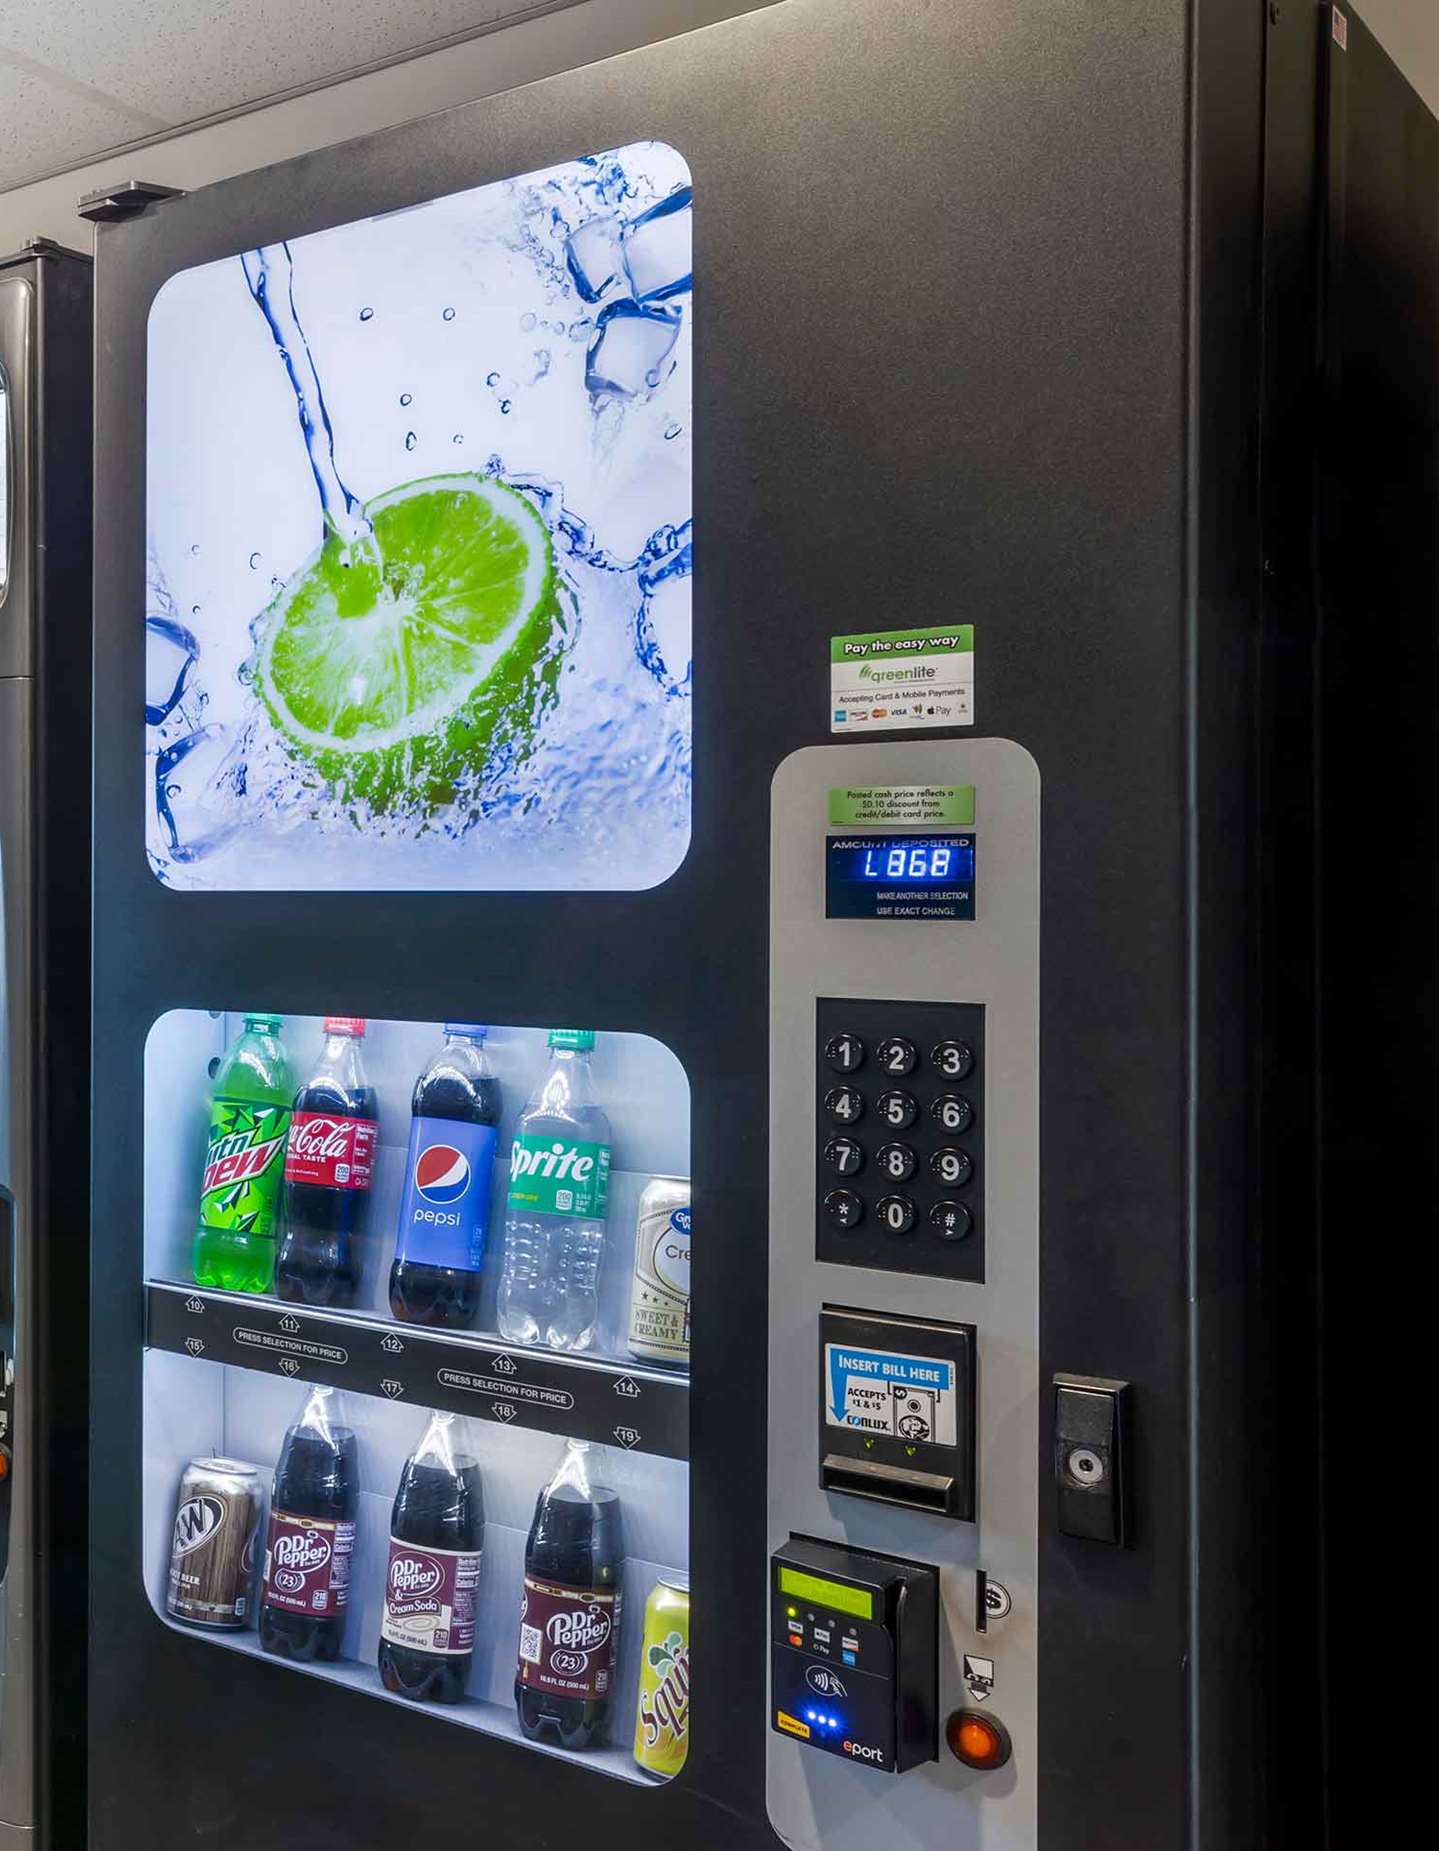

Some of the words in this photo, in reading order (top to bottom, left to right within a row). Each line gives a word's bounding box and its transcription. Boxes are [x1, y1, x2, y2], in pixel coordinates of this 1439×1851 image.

[845, 643, 869, 655] Pay
[872, 640, 892, 651] the
[895, 639, 926, 651] easy
[930, 636, 960, 648] way
[871, 666, 935, 684] greenlite
[839, 695, 874, 703] Accepting
[875, 692, 893, 701] Card
[894, 692, 900, 700] &
[902, 690, 926, 699] Mobile
[928, 688, 965, 698] Payments
[935, 706, 952, 716] Pay
[847, 791, 872, 799] Posted
[874, 791, 892, 799] cash
[894, 790, 914, 800] price
[917, 788, 946, 798] reflects
[886, 800, 919, 808] discount
[855, 810, 901, 819] credit/debit
[903, 810, 921, 818] card
[877, 892, 895, 900] MAKE
[895, 892, 929, 900] ANOTHER
[930, 892, 969, 900] SELECTION
[876, 907, 892, 915] USE
[894, 907, 920, 915] EXACT
[921, 907, 956, 916] CHANGE
[838, 1042, 851, 1067] 1
[889, 1046, 904, 1070] 2
[942, 1049, 961, 1074] 3
[835, 1094, 852, 1119] 4
[887, 1099, 903, 1124] 5
[942, 1102, 961, 1128] 6
[303, 1155, 326, 1163] TASTE
[510, 1140, 594, 1182] Sprite
[836, 1146, 851, 1171] 7
[888, 1151, 904, 1176] 8
[941, 1155, 960, 1181] 9
[413, 1209, 461, 1227] pepsi
[887, 1203, 904, 1229] 0
[665, 1244, 691, 1260] Cre
[190, 1301, 201, 1310] 10
[283, 1319, 295, 1329] 11
[635, 1310, 669, 1325] SWEET
[671, 1317, 679, 1327] &
[190, 1340, 201, 1350] 15
[239, 1331, 261, 1344] PRESS
[262, 1335, 302, 1351] SELECTION
[302, 1343, 319, 1354] FOR
[319, 1346, 342, 1360] PRICE
[386, 1339, 398, 1349] 12
[284, 1361, 295, 1371] 16
[497, 1360, 510, 1371] 13
[838, 1355, 879, 1373] INSERT
[882, 1363, 907, 1378] BILL
[910, 1367, 940, 1383] HERE
[386, 1383, 398, 1393] 17
[443, 1373, 471, 1386] PRESS
[472, 1377, 519, 1394] SELECTION
[520, 1388, 539, 1399] FOR
[540, 1391, 567, 1404] PRICE
[620, 1382, 634, 1393] 14
[847, 1387, 887, 1401] ACCEPTS
[497, 1406, 511, 1417] 18
[852, 1400, 861, 1408] $1
[863, 1401, 870, 1409] &
[872, 1403, 881, 1411] $5
[620, 1431, 634, 1442] 19
[292, 1535, 314, 1551] Dr
[277, 1536, 327, 1568] Pepper
[404, 1559, 423, 1576] Dr
[181, 1573, 201, 1586] BEER
[282, 1574, 294, 1587] 23
[392, 1560, 435, 1590] Pepper
[395, 1590, 404, 1601] &
[390, 1603, 414, 1614] Cream
[414, 1599, 438, 1611] Soda
[571, 1611, 596, 1630] Dr
[555, 1613, 607, 1649] Pepper
[561, 1655, 576, 1669] 23
[843, 1740, 884, 1763] eport
